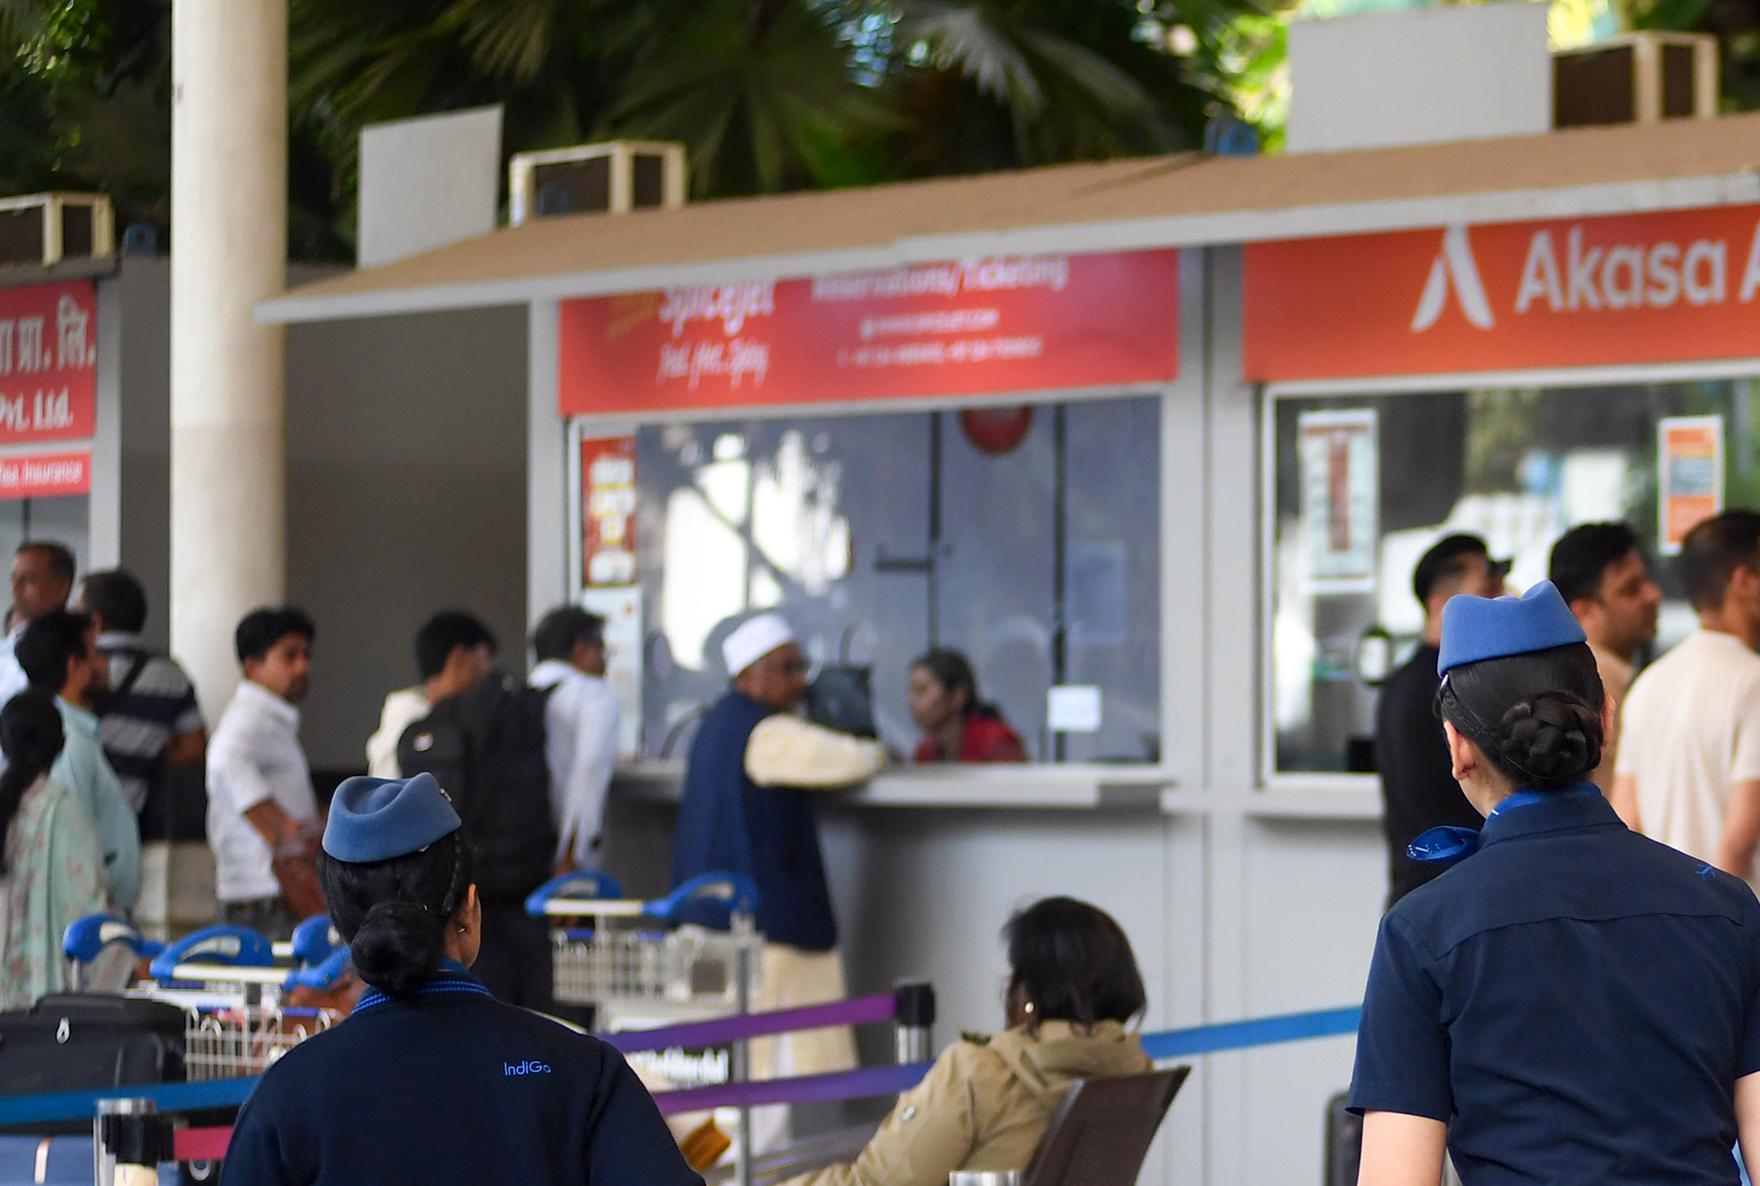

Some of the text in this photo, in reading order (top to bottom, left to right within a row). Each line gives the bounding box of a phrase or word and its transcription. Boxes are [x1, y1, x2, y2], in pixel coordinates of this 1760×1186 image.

[1514, 225, 1727, 314] Akasa
[33, 386, 74, 430] Ltd.
[504, 1060, 551, 1076] IndiGo
